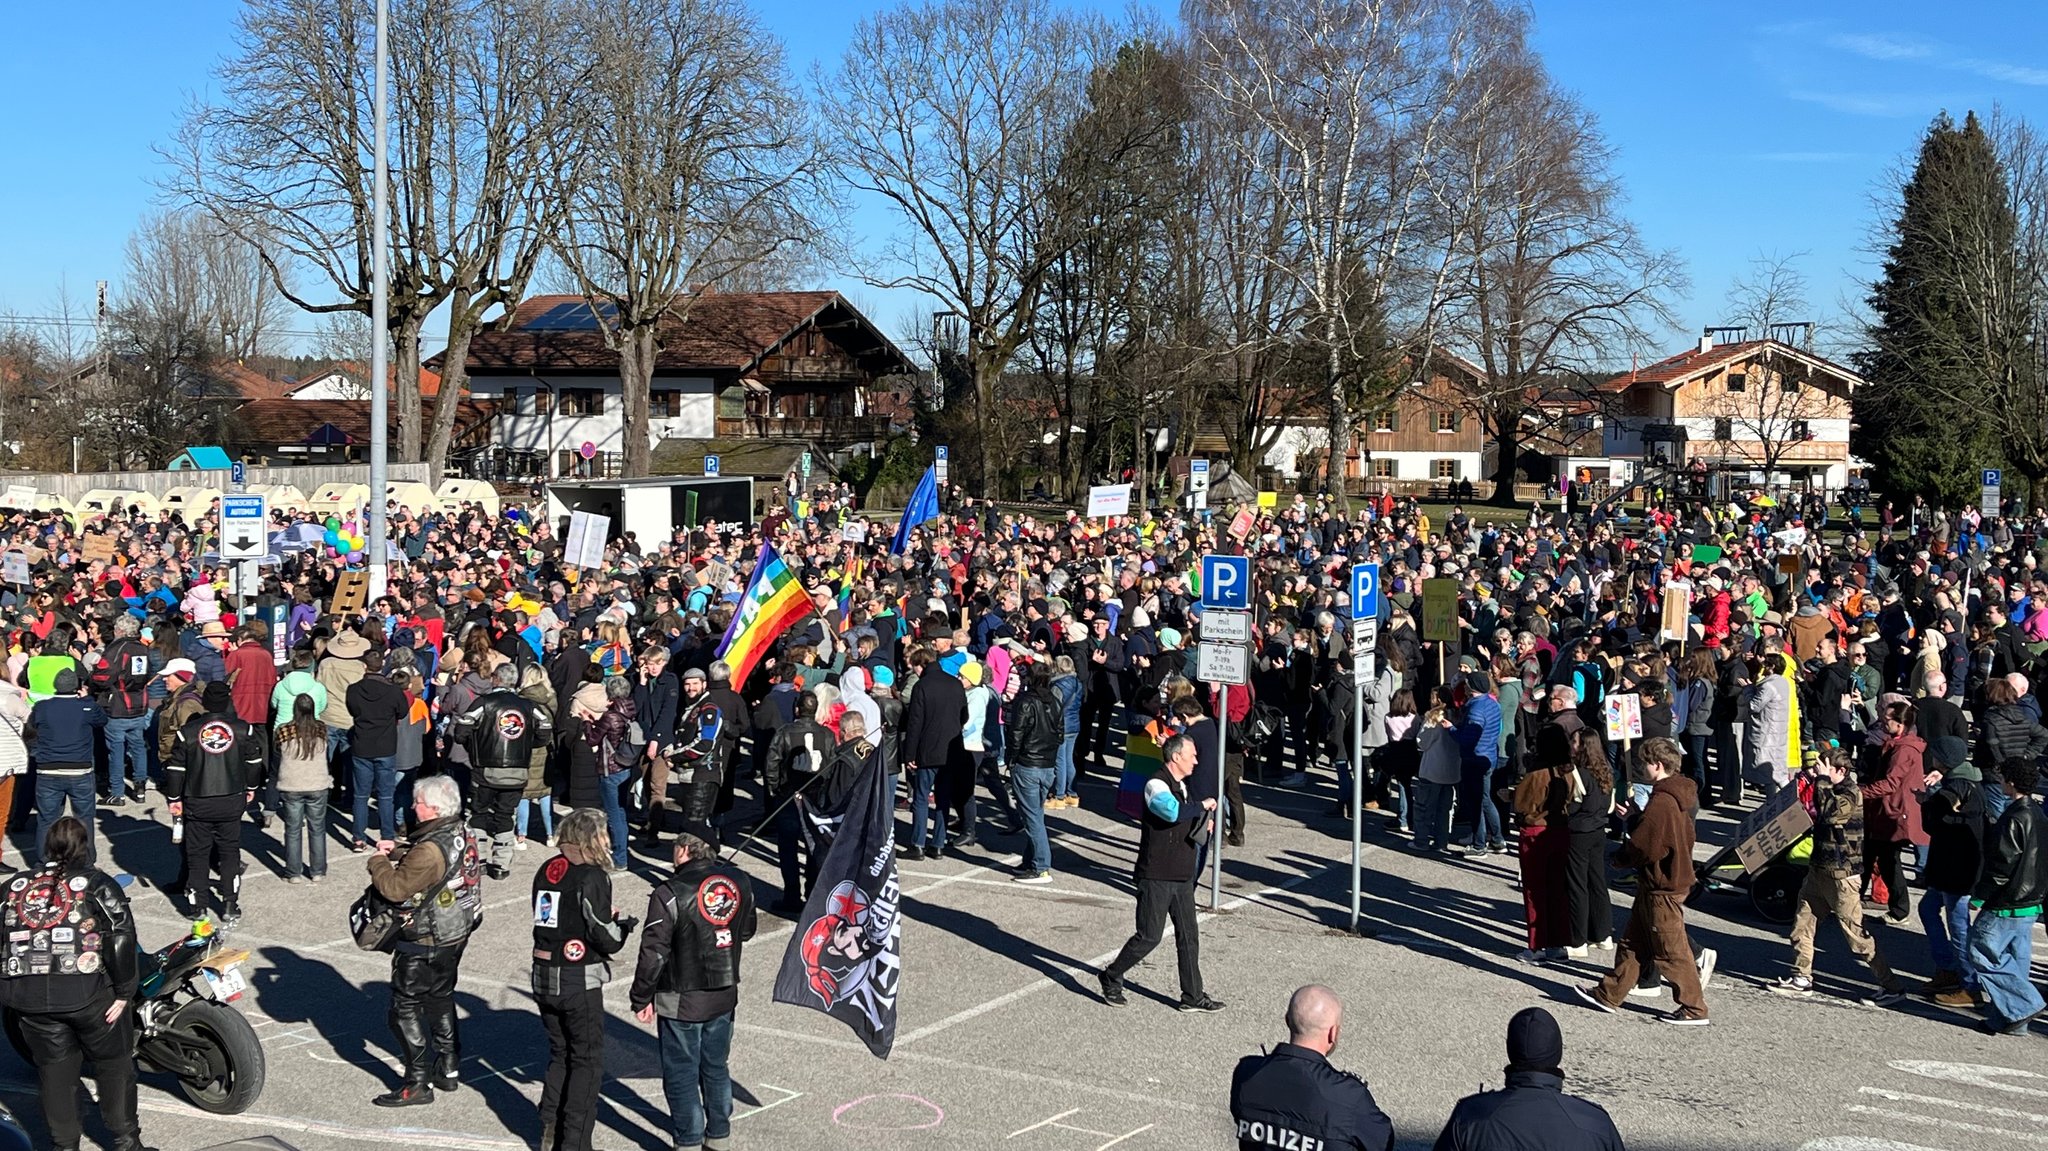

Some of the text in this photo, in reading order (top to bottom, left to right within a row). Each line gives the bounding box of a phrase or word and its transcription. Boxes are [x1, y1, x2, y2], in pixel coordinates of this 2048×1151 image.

[1986, 471, 1996, 485] P
[1212, 562, 1238, 601] P
[1358, 571, 1373, 612] P
[1203, 626, 1244, 636] Parkschein
[1217, 618, 1230, 626] mit
[1208, 663, 1217, 671] Sa
[1767, 819, 1789, 850] UNS
[1238, 1119, 1324, 1151] POLIZEI
